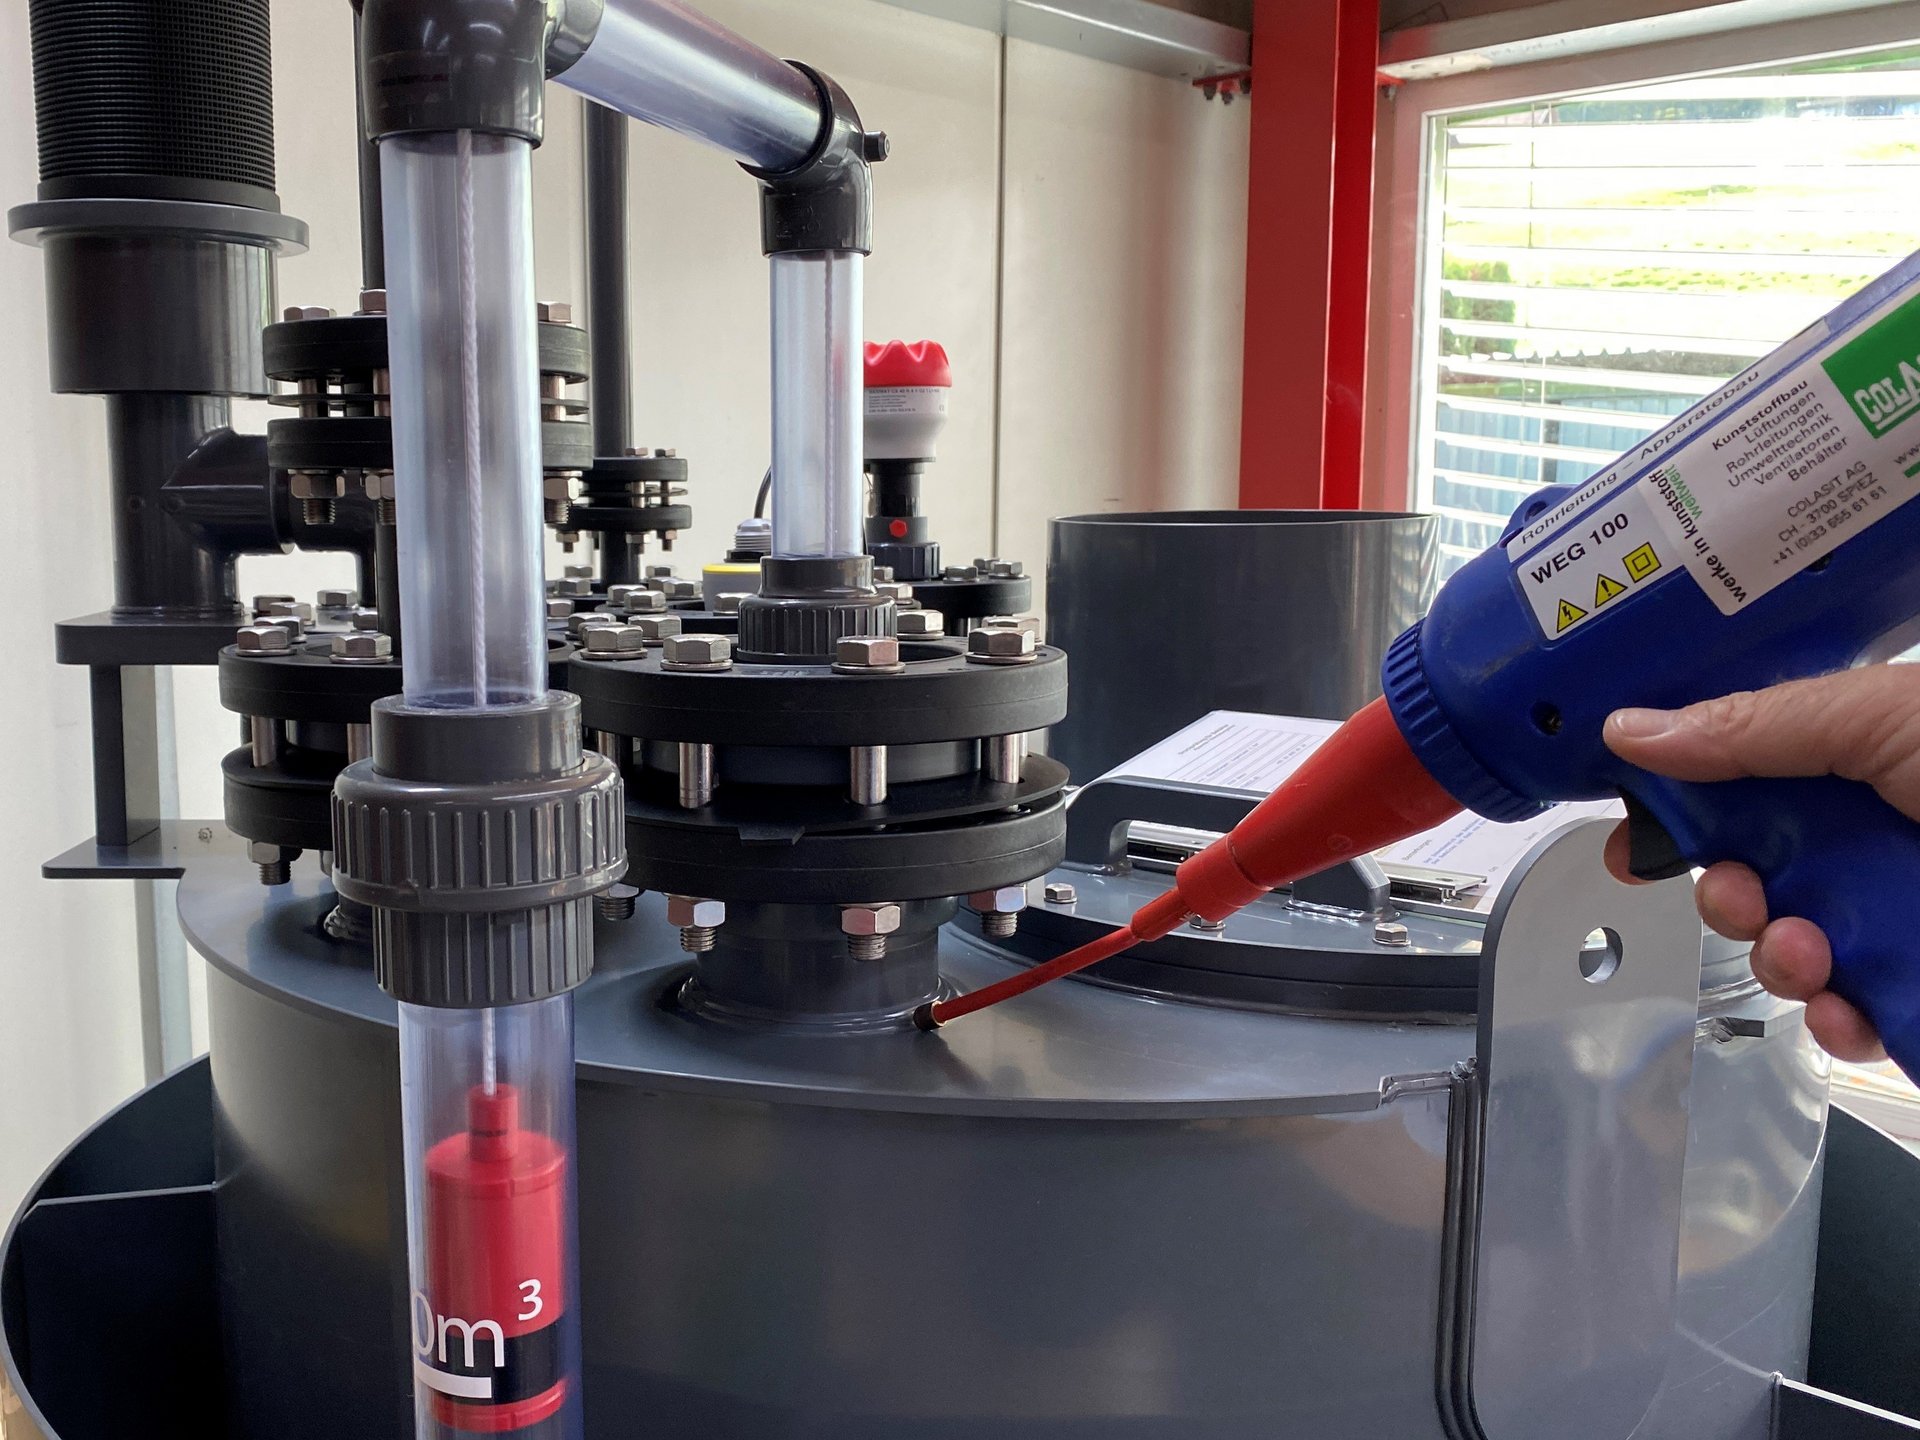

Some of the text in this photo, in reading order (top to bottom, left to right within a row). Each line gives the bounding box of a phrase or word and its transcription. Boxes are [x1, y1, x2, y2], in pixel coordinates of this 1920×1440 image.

[1712, 380, 1808, 450] Kunststoffbau
[1744, 391, 1816, 444] Lüftungen
[1854, 354, 1920, 424] COLA
[1522, 472, 1617, 544] Rohrleitung
[1640, 371, 1760, 460] Apparatebau
[1726, 402, 1824, 473] Rohrleitungen
[1728, 413, 1833, 488] Umwelttechnik
[1754, 425, 1840, 485] Ventilatoren
[1787, 437, 1848, 481] Behälter
[1664, 464, 1703, 520] weltweit
[1778, 525, 1799, 542] CH
[1806, 499, 1838, 524] 3700
[1837, 471, 1879, 502] SPIEZ
[1787, 460, 1867, 518] COLASIT AG
[1531, 513, 1629, 584] WEG 100
[1649, 469, 1747, 602] werke in kunststoff
[1773, 547, 1794, 565] +41
[1852, 497, 1869, 512] 61
[1870, 485, 1887, 500] 61
